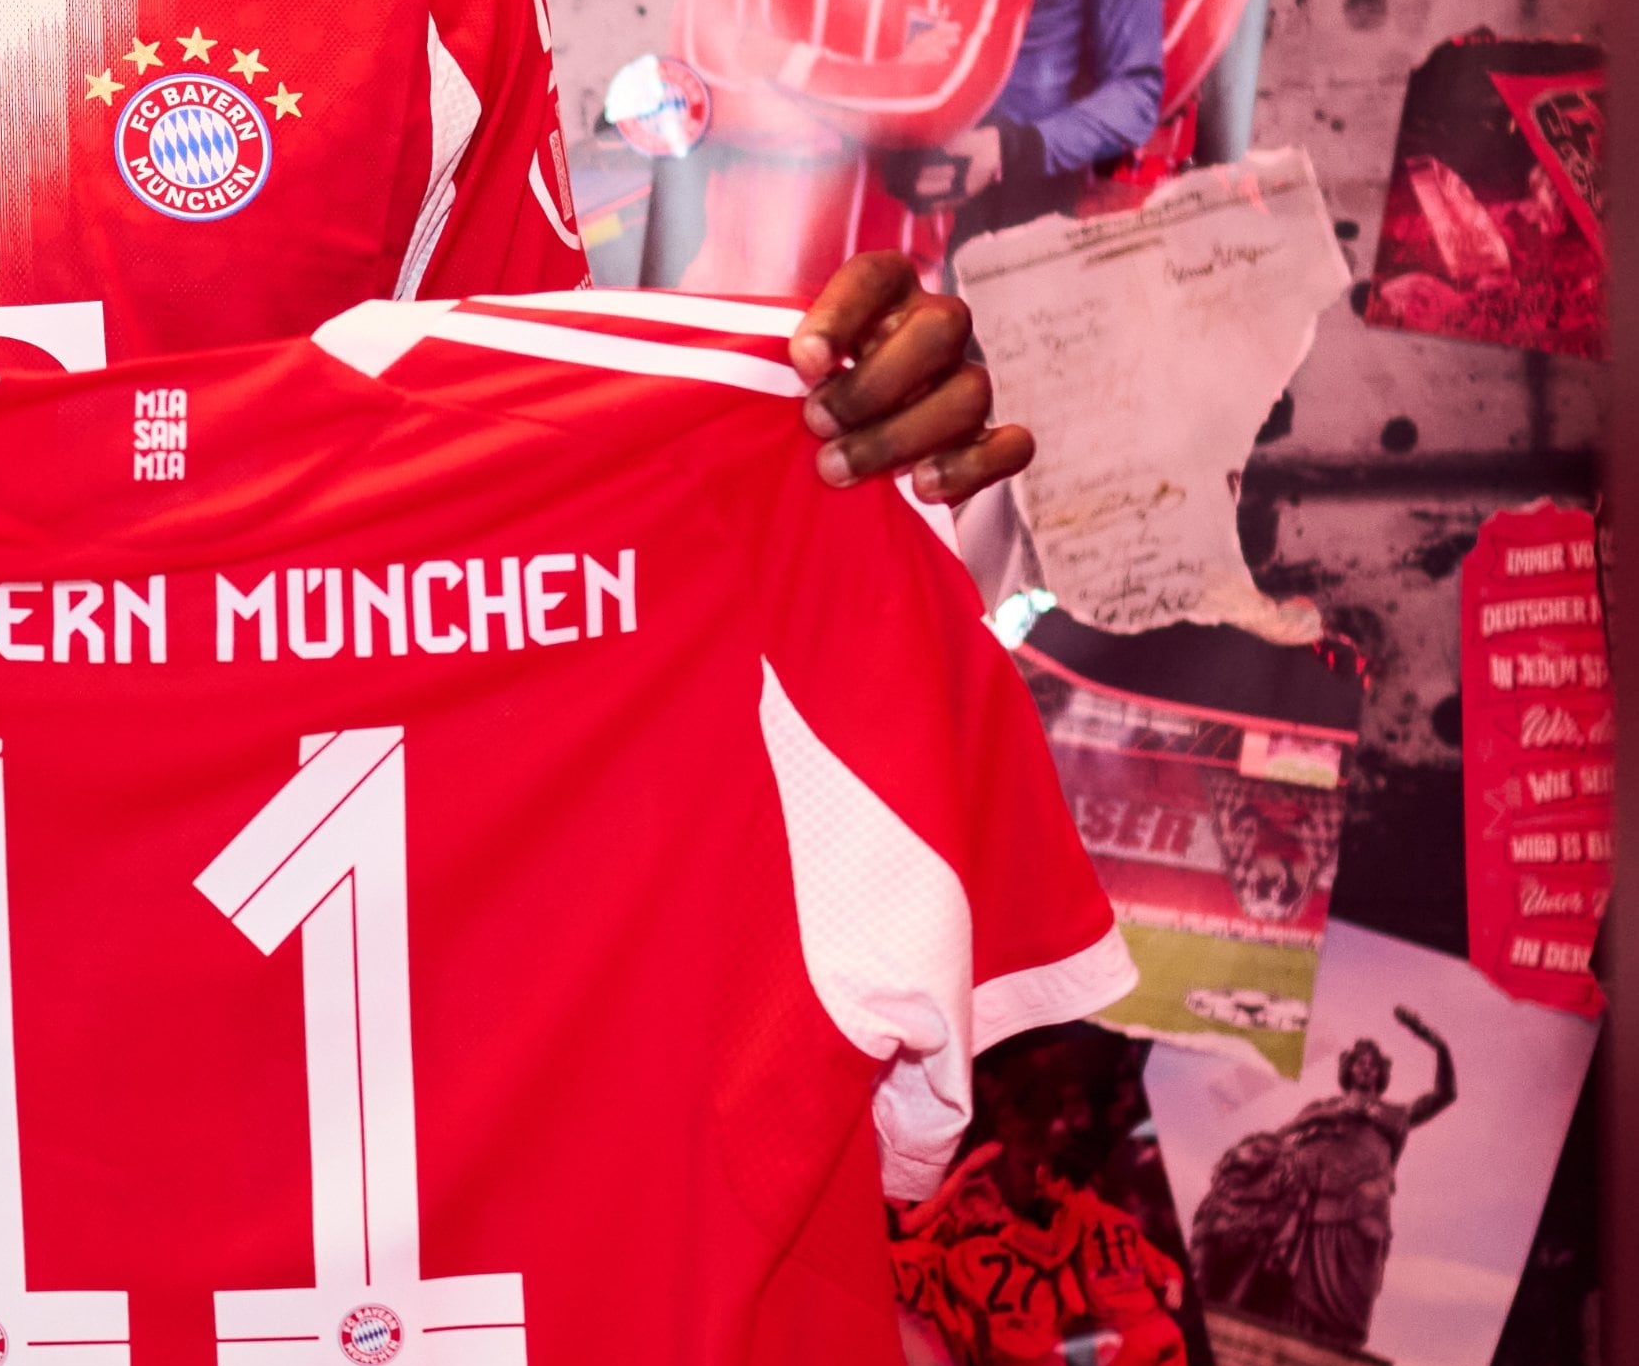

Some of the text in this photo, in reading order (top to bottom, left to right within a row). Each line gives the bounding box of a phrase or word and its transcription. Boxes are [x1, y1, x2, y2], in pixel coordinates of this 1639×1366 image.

[129, 84, 259, 142] FC BAYERN
[129, 163, 256, 212] MÜNCHEN
[134, 388, 188, 418] MIA
[133, 421, 188, 451] SAN
[133, 452, 187, 482] MIA
[215, 547, 639, 664] MÜNCHEN
[978, 1253, 1050, 1314] 27
